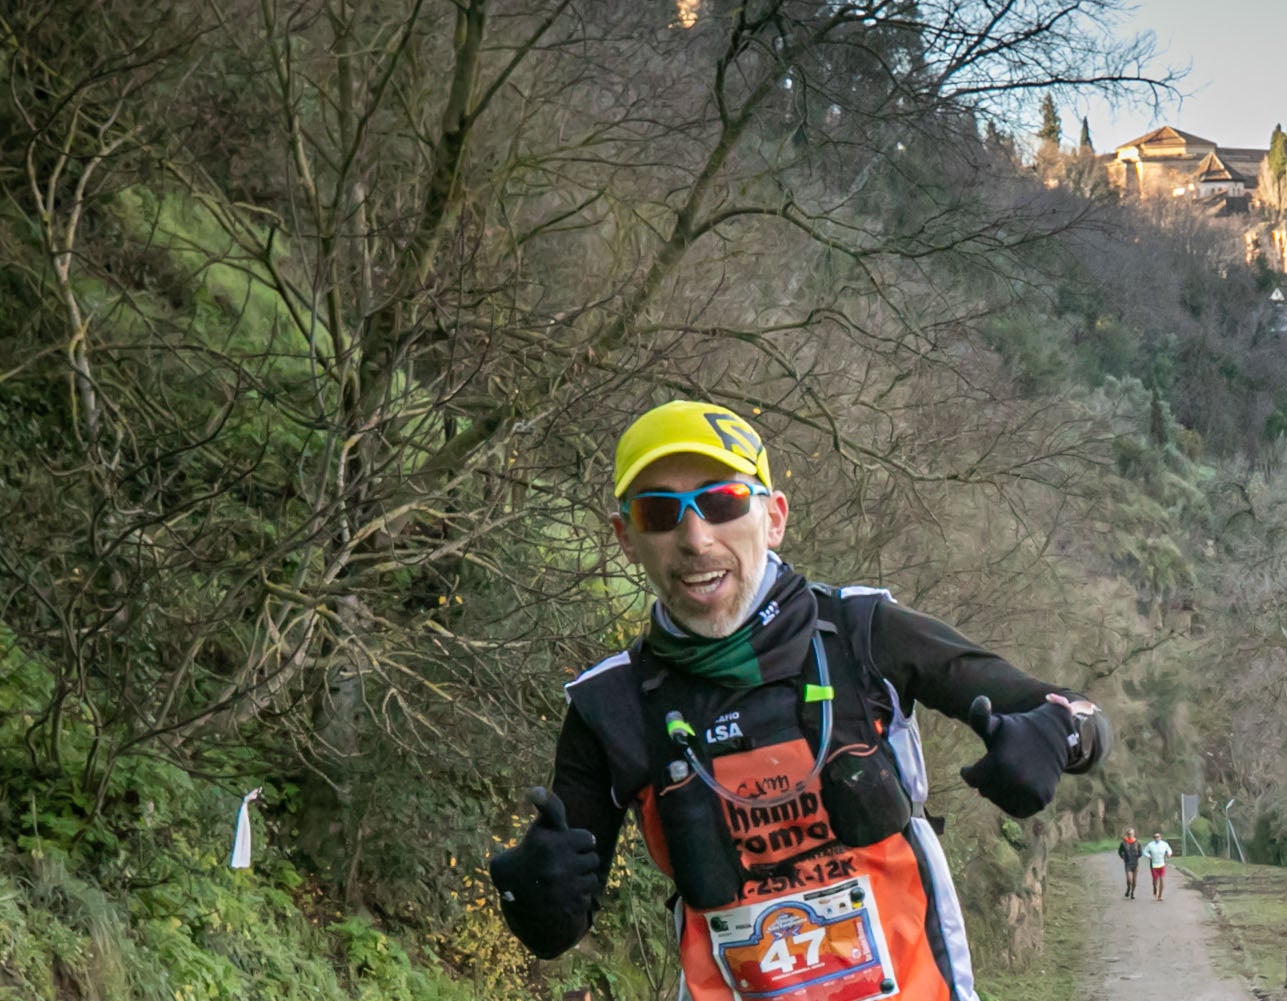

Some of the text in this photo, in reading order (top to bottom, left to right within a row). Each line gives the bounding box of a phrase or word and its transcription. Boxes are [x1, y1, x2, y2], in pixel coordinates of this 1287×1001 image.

[715, 711, 740, 723] AFIO
[706, 722, 744, 744] LSA
[760, 927, 826, 974] 47
